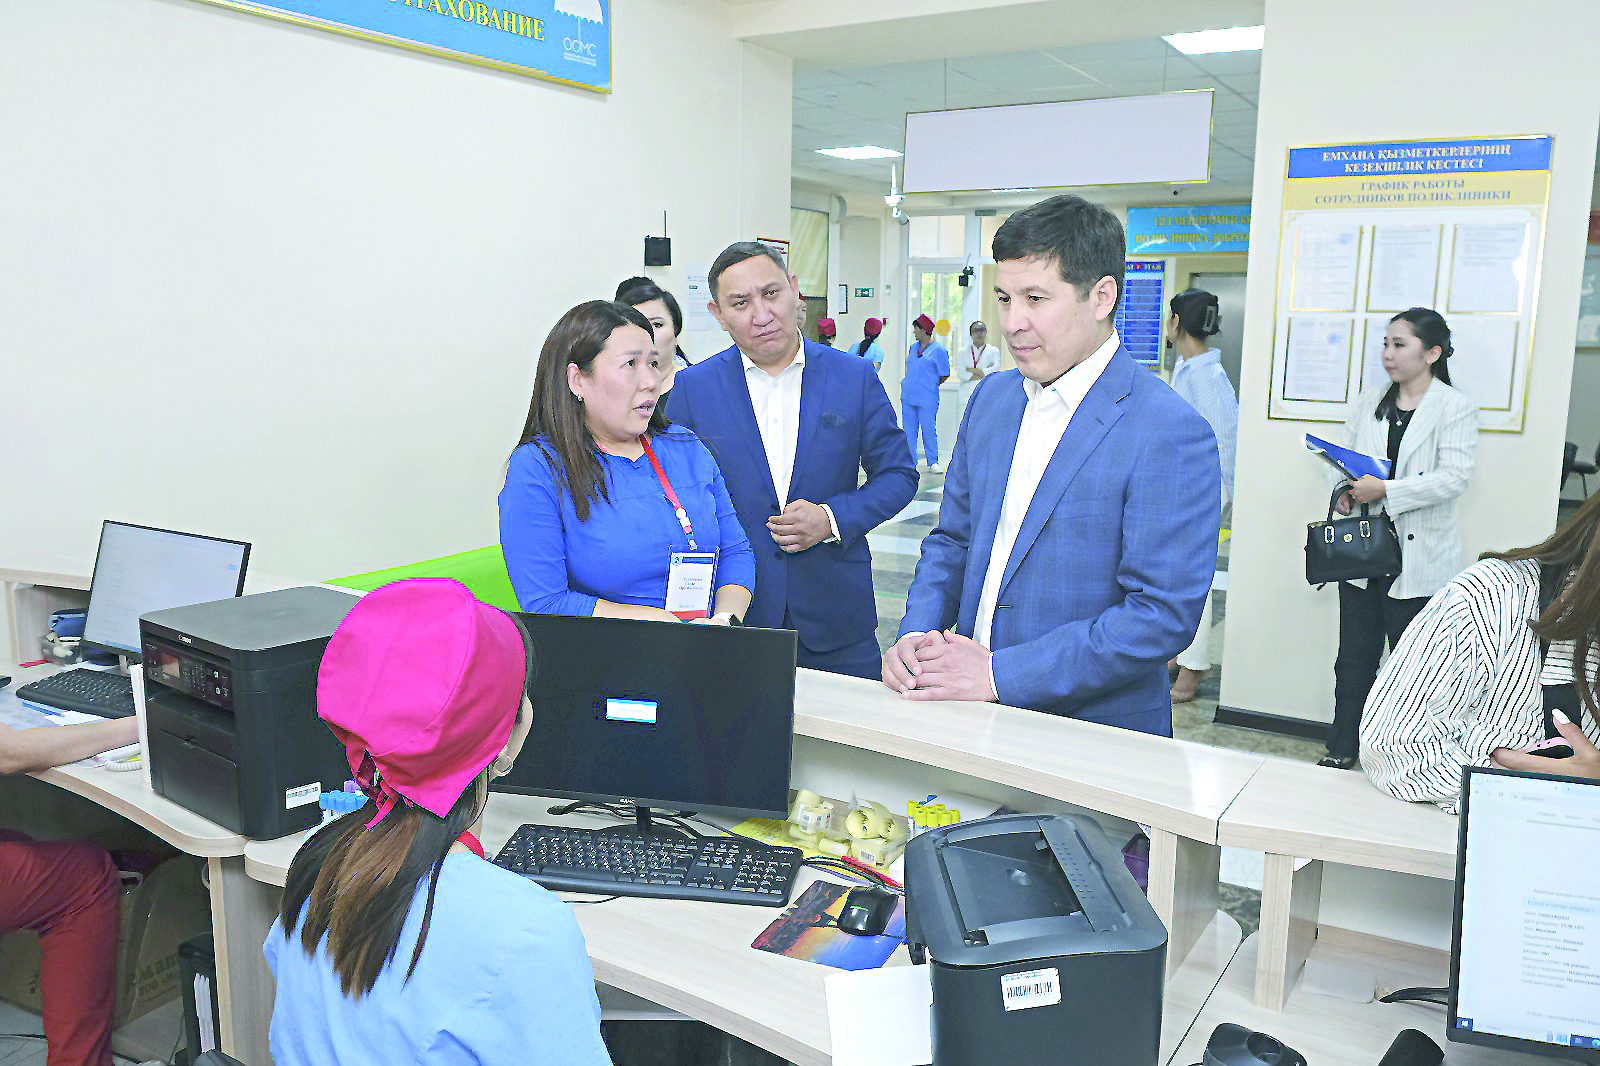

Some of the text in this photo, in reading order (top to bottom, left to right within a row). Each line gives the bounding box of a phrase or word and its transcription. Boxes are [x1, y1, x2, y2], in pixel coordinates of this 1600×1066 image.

[1322, 150, 1376, 161] ЕМХАНА
[1426, 158, 1484, 171] КЕСТЕСІ
[1361, 179, 1466, 191] ГРАФИК РАБОТЫ
[1315, 190, 1512, 204] СОТРУДНИКОВ ПОЛИКЛИНИКИ
